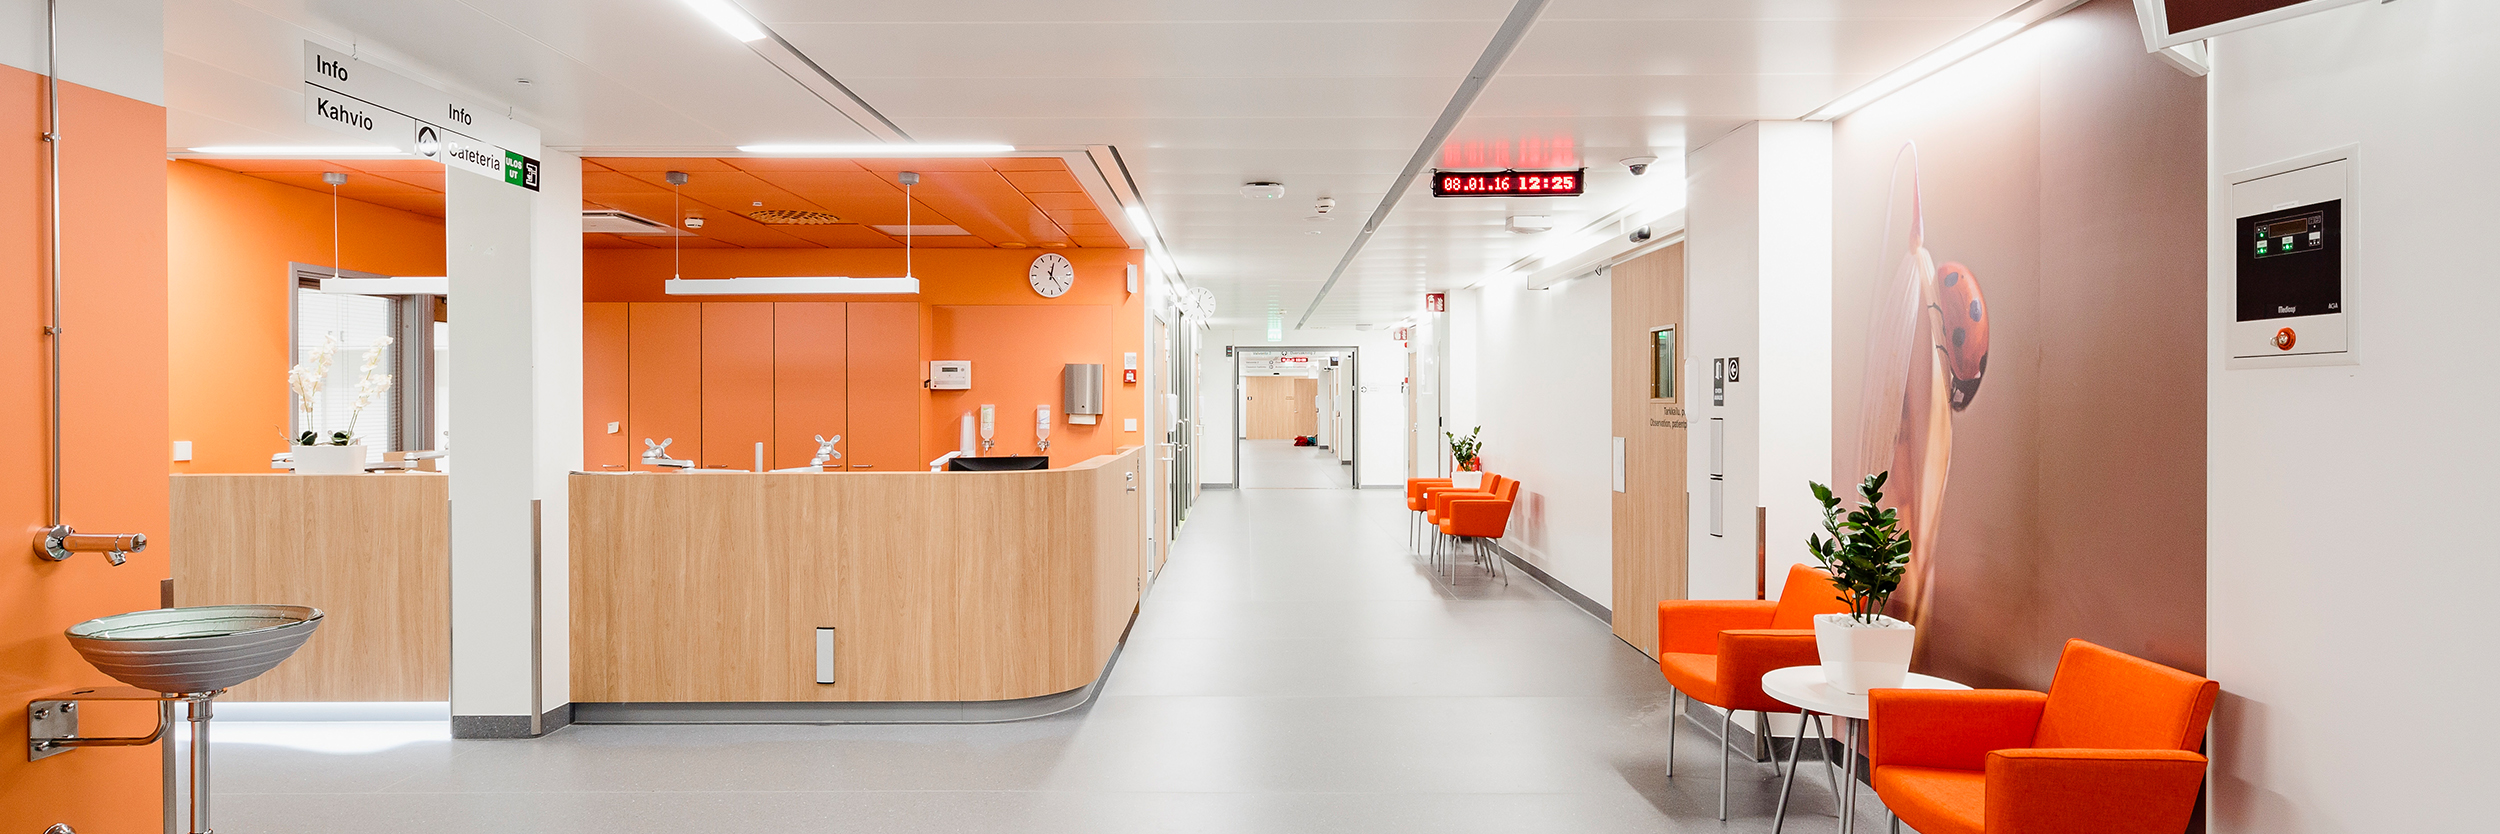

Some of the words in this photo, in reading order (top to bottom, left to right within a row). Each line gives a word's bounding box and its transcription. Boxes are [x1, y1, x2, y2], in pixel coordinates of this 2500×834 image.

[316, 54, 348, 81] Info
[317, 97, 373, 131] Kahvio
[448, 103, 472, 125] Info
[448, 141, 500, 170] Cafeteria
[505, 157, 522, 169] ULOS
[509, 169, 518, 179] UT
[1444, 177, 1510, 190] 08.01.16
[1519, 176, 1574, 190] 12:25
